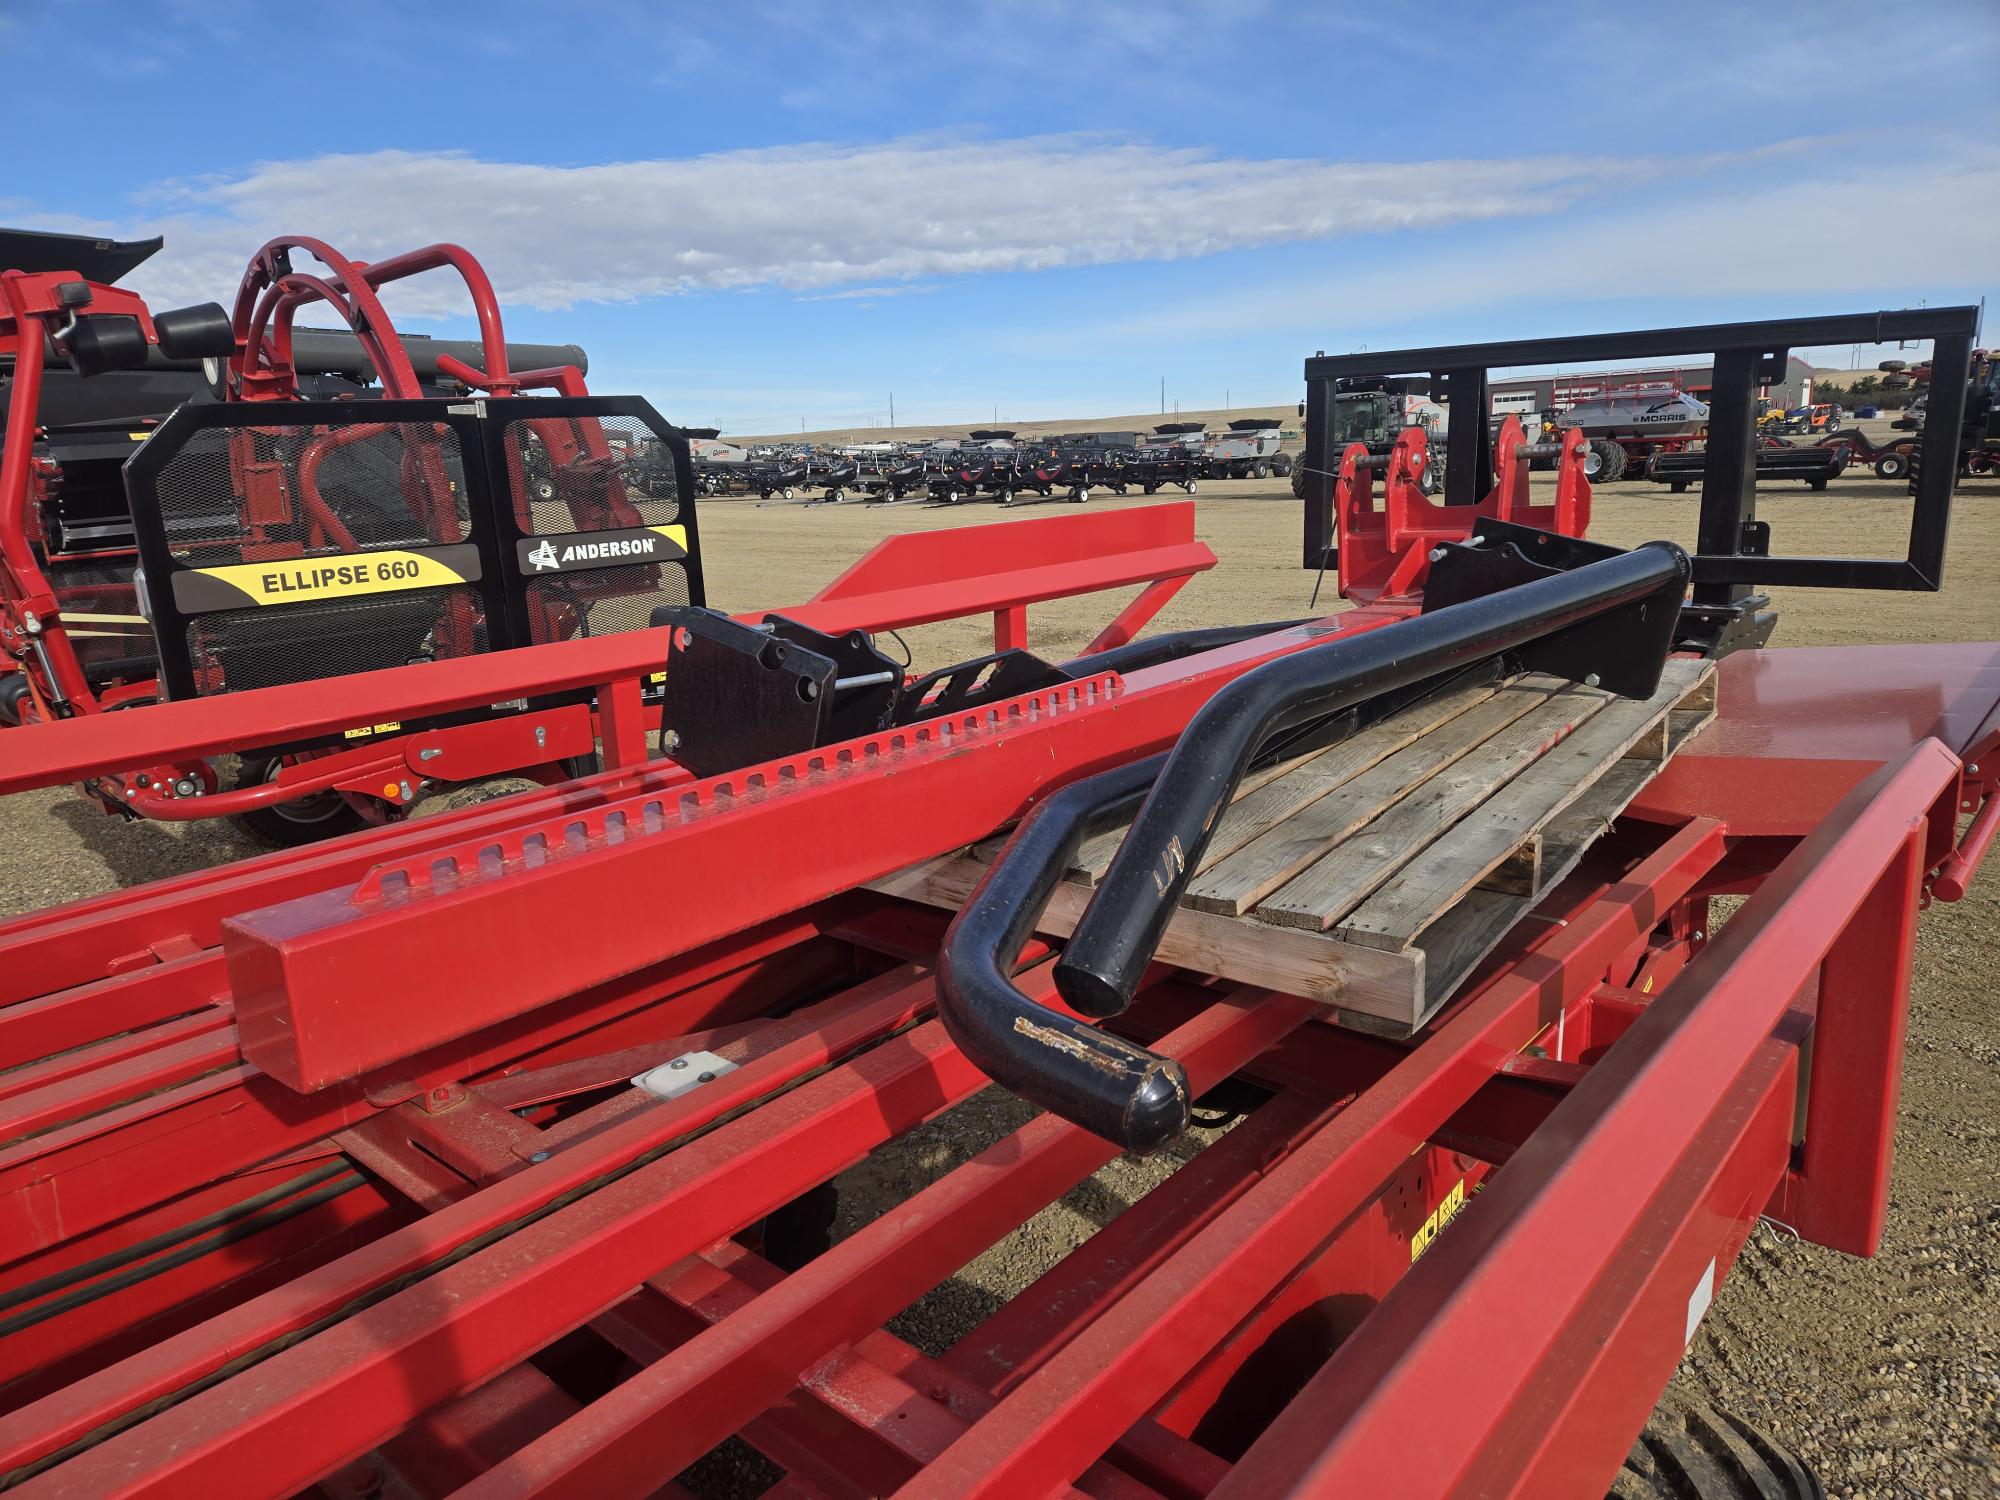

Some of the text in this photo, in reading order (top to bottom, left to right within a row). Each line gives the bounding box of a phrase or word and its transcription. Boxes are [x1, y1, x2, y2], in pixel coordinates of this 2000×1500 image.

[1640, 413, 1686, 423] MORRIS
[561, 538, 654, 562] ANDERSON
[262, 559, 420, 593] ELLIPSE 660
